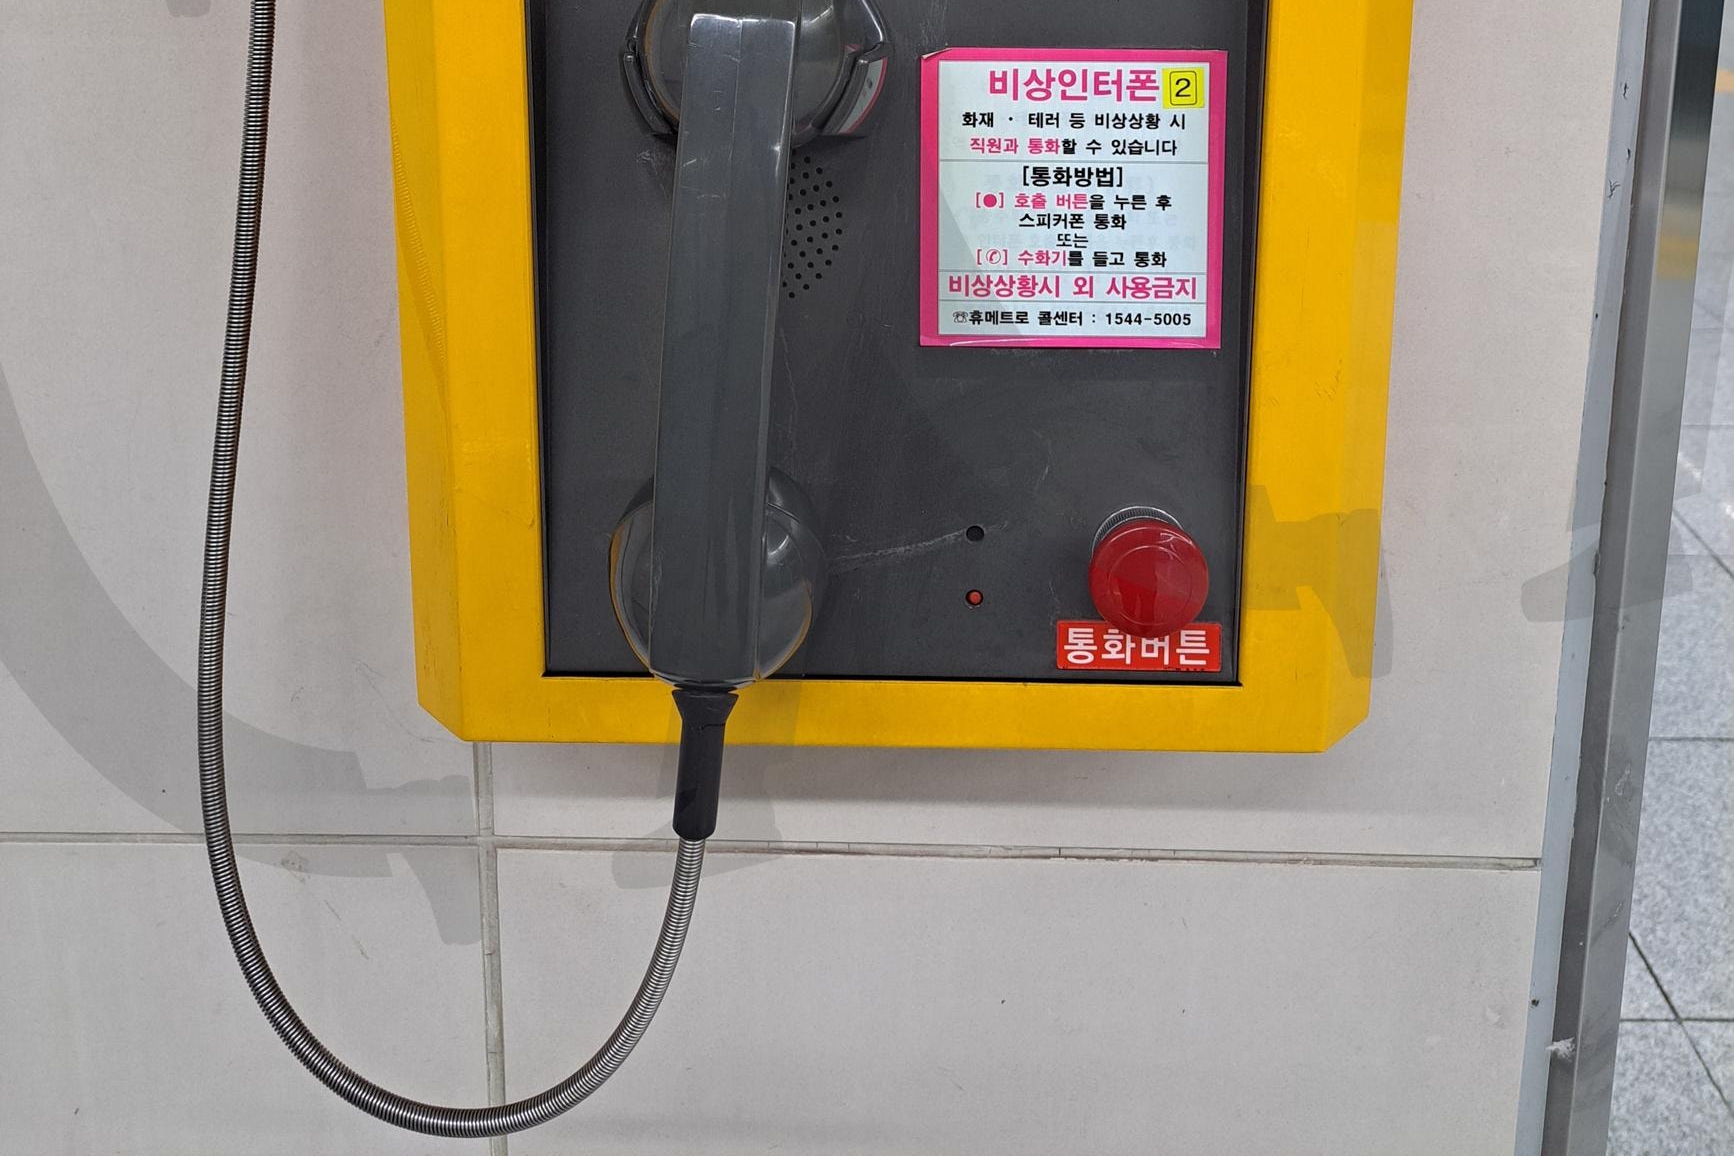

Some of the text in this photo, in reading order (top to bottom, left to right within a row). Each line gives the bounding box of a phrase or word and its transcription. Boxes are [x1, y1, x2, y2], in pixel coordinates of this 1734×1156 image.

[990, 69, 1159, 101] 비상인터폰
[1176, 78, 1190, 97] 2
[962, 112, 993, 128] 화재
[1029, 112, 1059, 128] 테러
[1069, 113, 1085, 129] 등
[1095, 113, 1160, 129] 비상상황
[1170, 114, 1185, 130] 시
[971, 138, 1177, 156] 직원과 통화할 수 있습니다
[1023, 166, 1122, 187] [통화방법]
[1015, 193, 1172, 211] 호출 버튼을 누른 후
[1019, 213, 1084, 229] 스피커폰
[1094, 214, 1126, 230] 통화
[1056, 233, 1088, 248] 또는
[1018, 250, 1167, 267] 수화기를 들고 통화
[949, 275, 1196, 299] 비상상황시 외 사용금지
[969, 310, 1029, 325] 휴메트로
[1038, 311, 1082, 326] 콜센터
[1106, 313, 1191, 325] 1544-5005
[1064, 628, 1209, 665] 통화버튼
